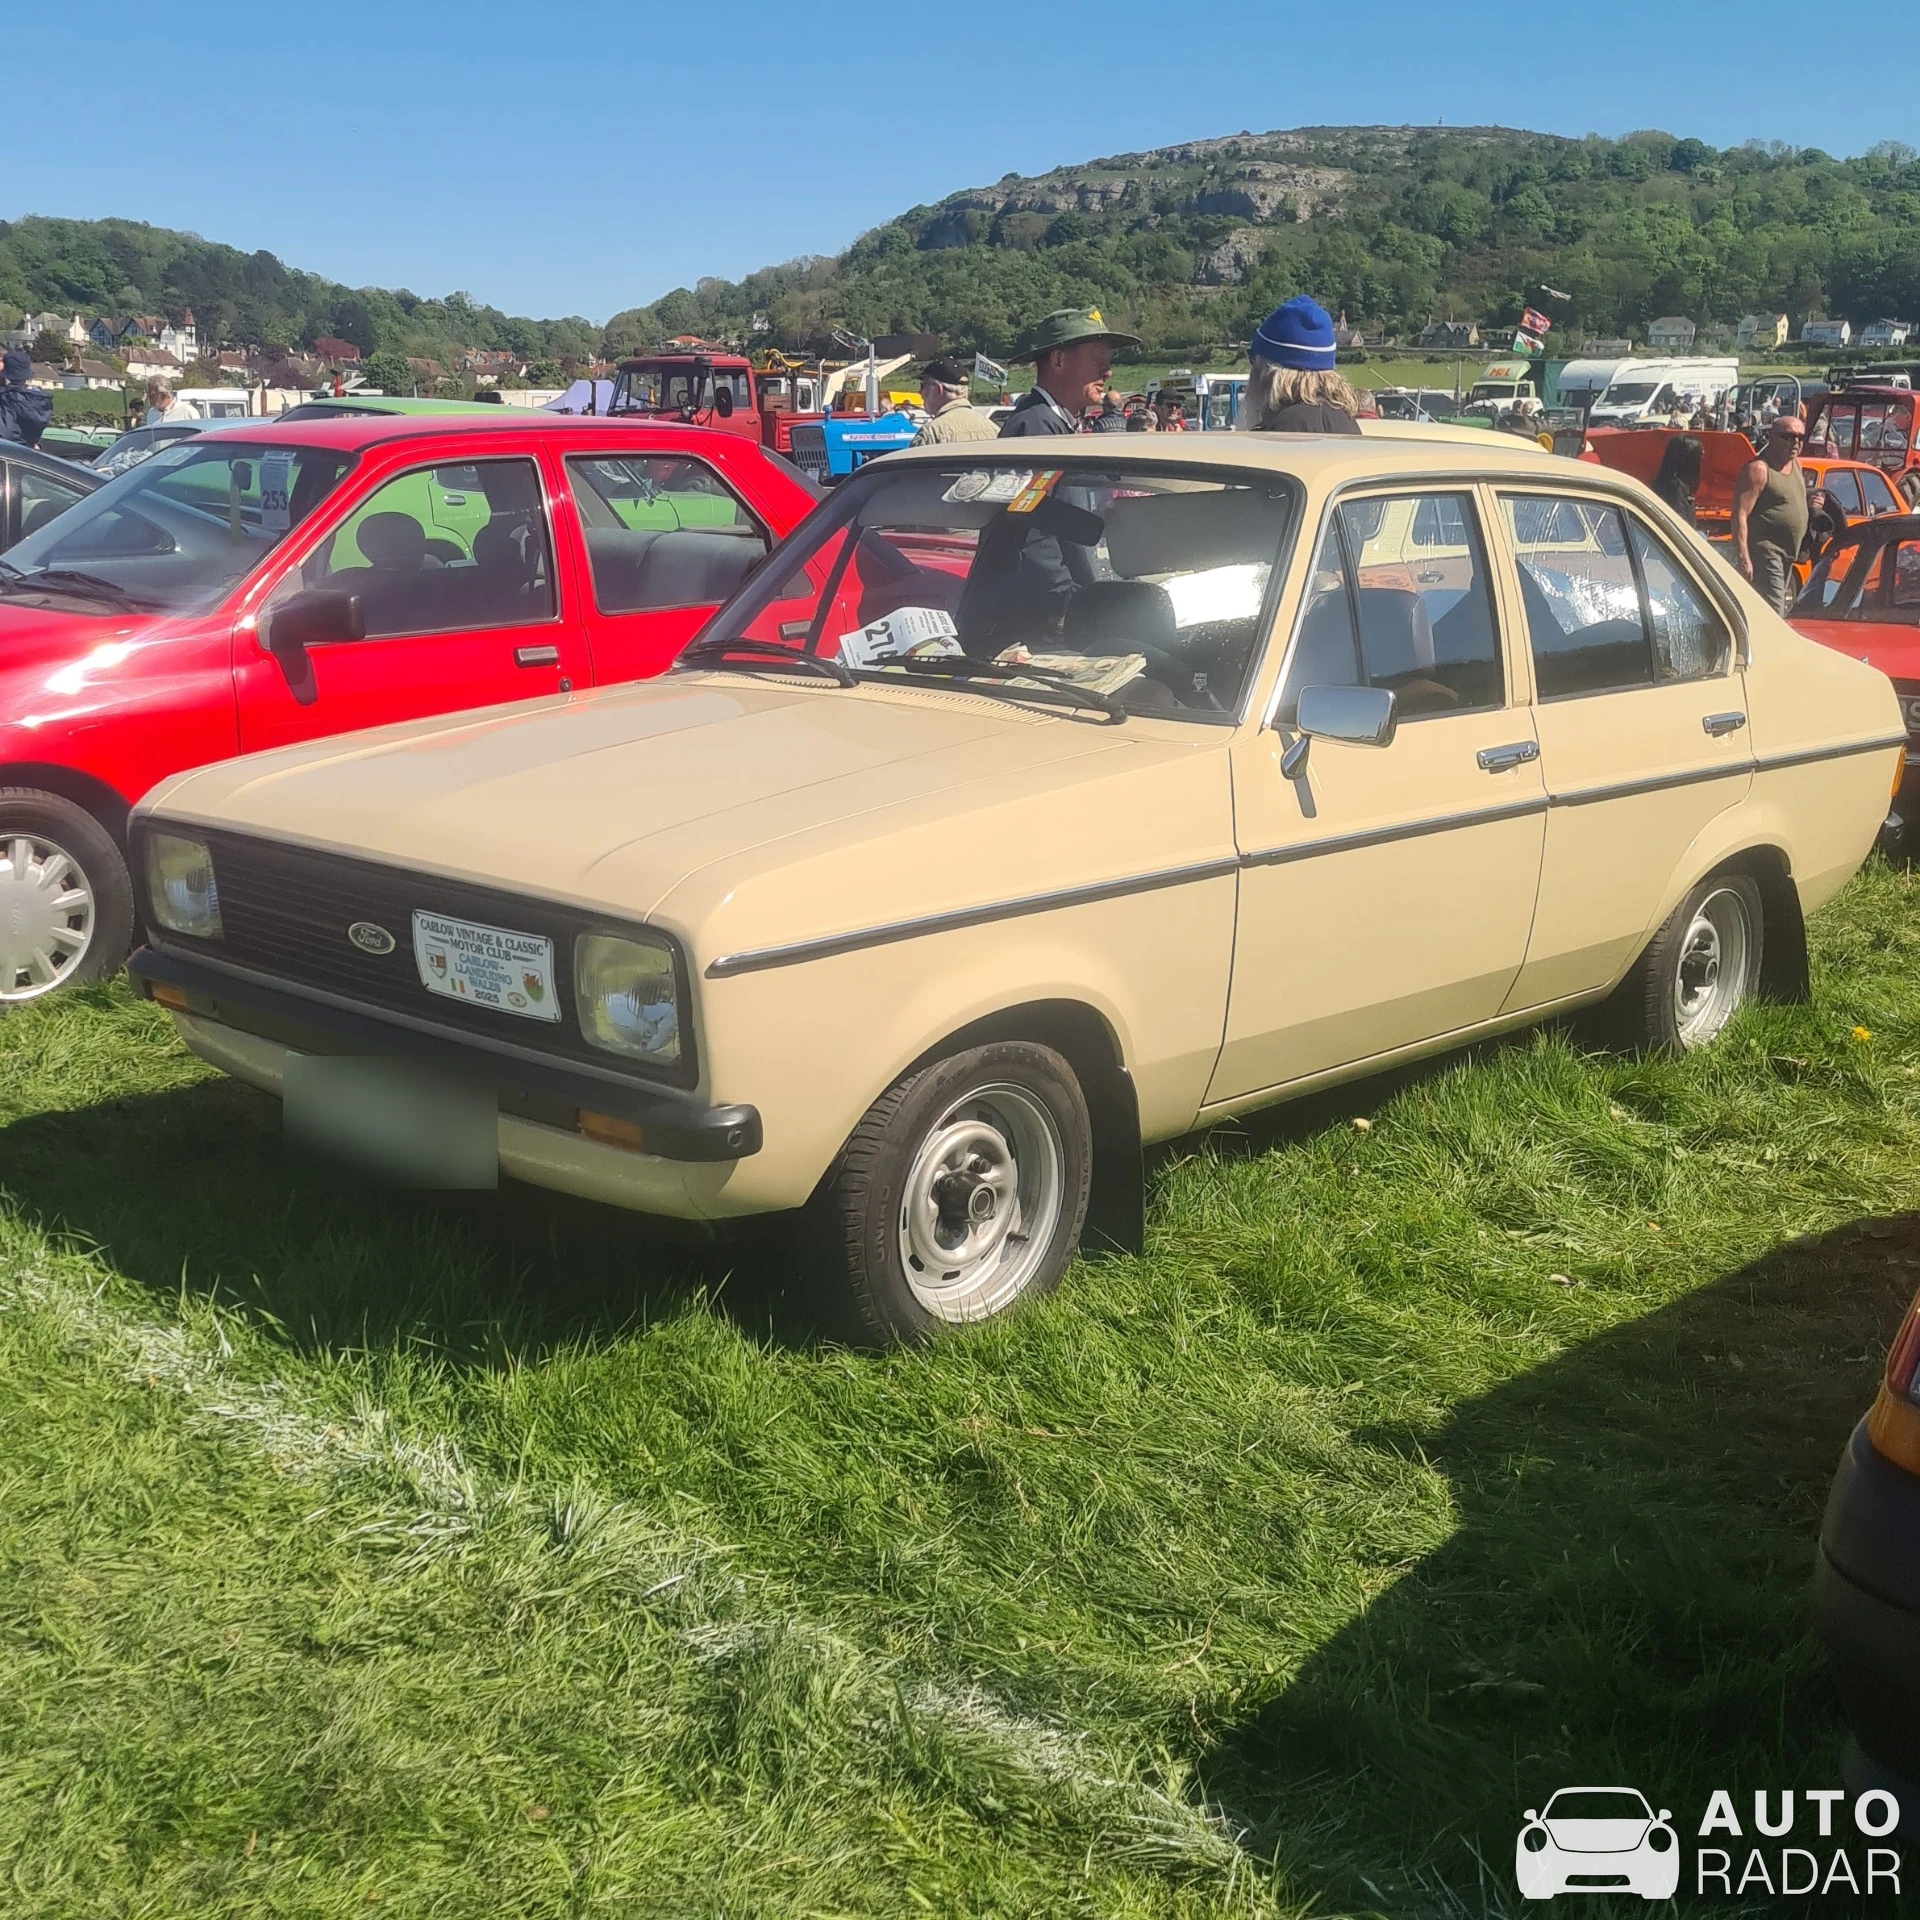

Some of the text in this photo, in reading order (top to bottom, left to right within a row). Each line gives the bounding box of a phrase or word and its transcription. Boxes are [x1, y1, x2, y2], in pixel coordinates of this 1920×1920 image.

[263, 490, 288, 511] 253
[357, 927, 383, 948] Ford
[420, 918, 544, 957] CARLOW VINTAGE & CLASSIC
[450, 938, 511, 962] MOTOR CLUB
[454, 961, 513, 986] LLANDUDNO
[468, 975, 502, 993] WALES
[474, 989, 500, 1003] 2025
